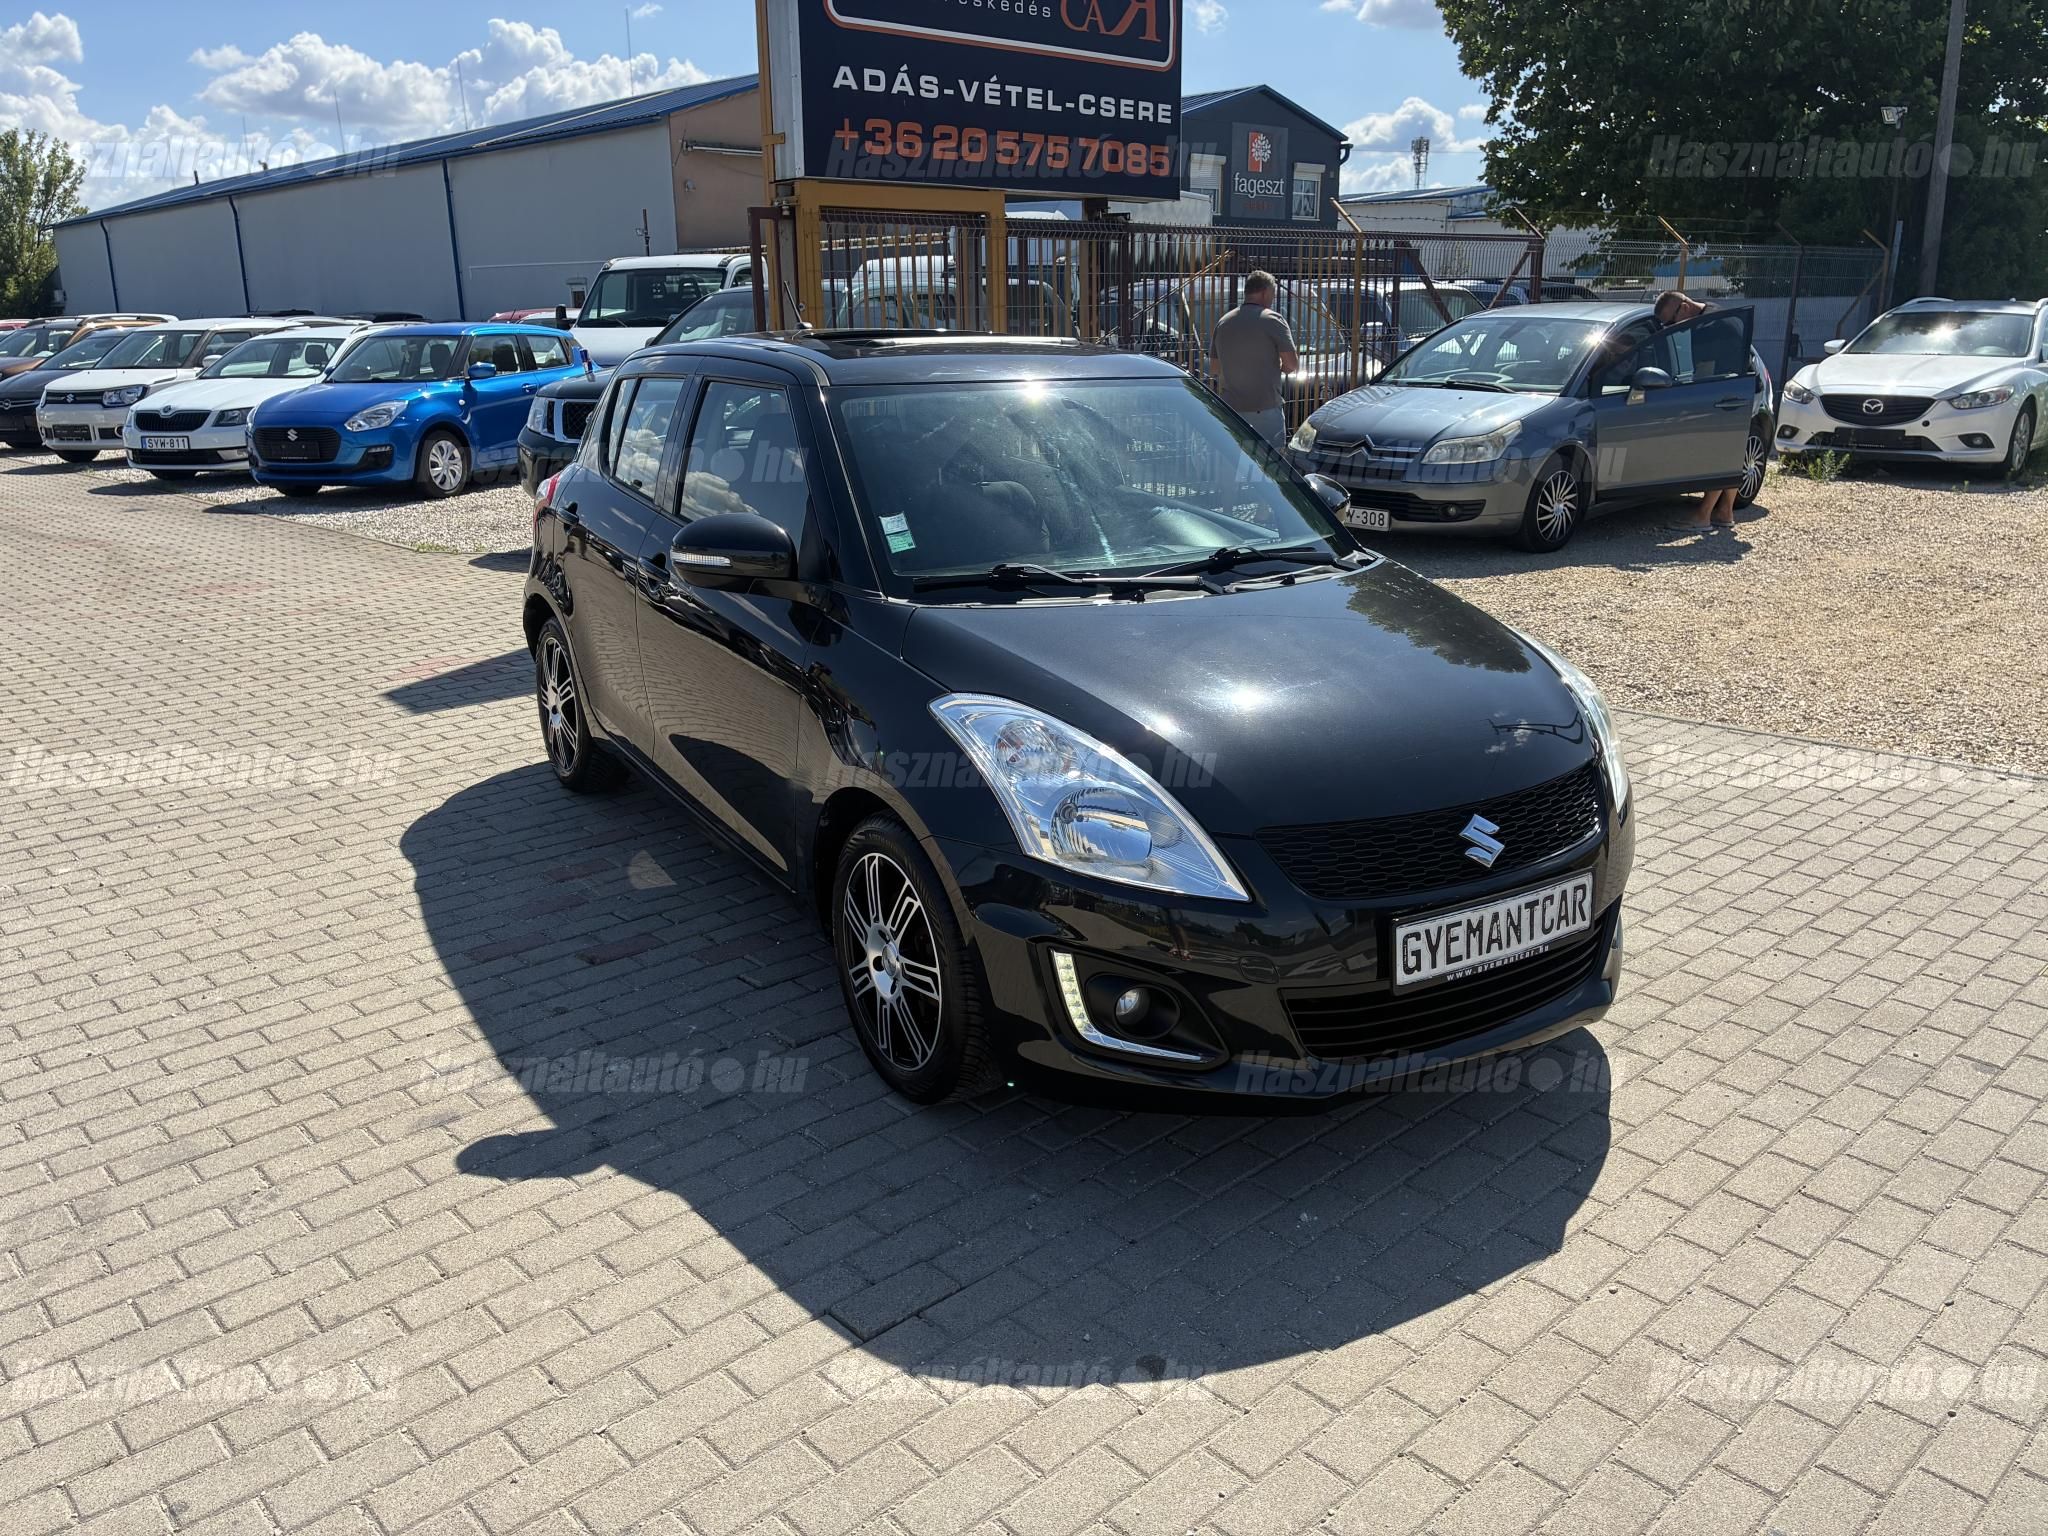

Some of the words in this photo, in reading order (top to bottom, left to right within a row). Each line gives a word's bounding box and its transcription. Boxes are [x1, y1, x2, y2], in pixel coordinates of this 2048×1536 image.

[832, 64, 1173, 124] ADÁS-VÉTEL-CSERE
[834, 117, 924, 159] +36
[932, 124, 989, 163] 20
[995, 130, 1071, 169] 575
[1077, 137, 1171, 176] 7085
[1233, 171, 1286, 199] fageszt
[147, 438, 186, 449] SYW-811
[1402, 883, 1588, 976] GYEMANTCAR
[1446, 944, 1550, 981] www.gyemantcar.hu
